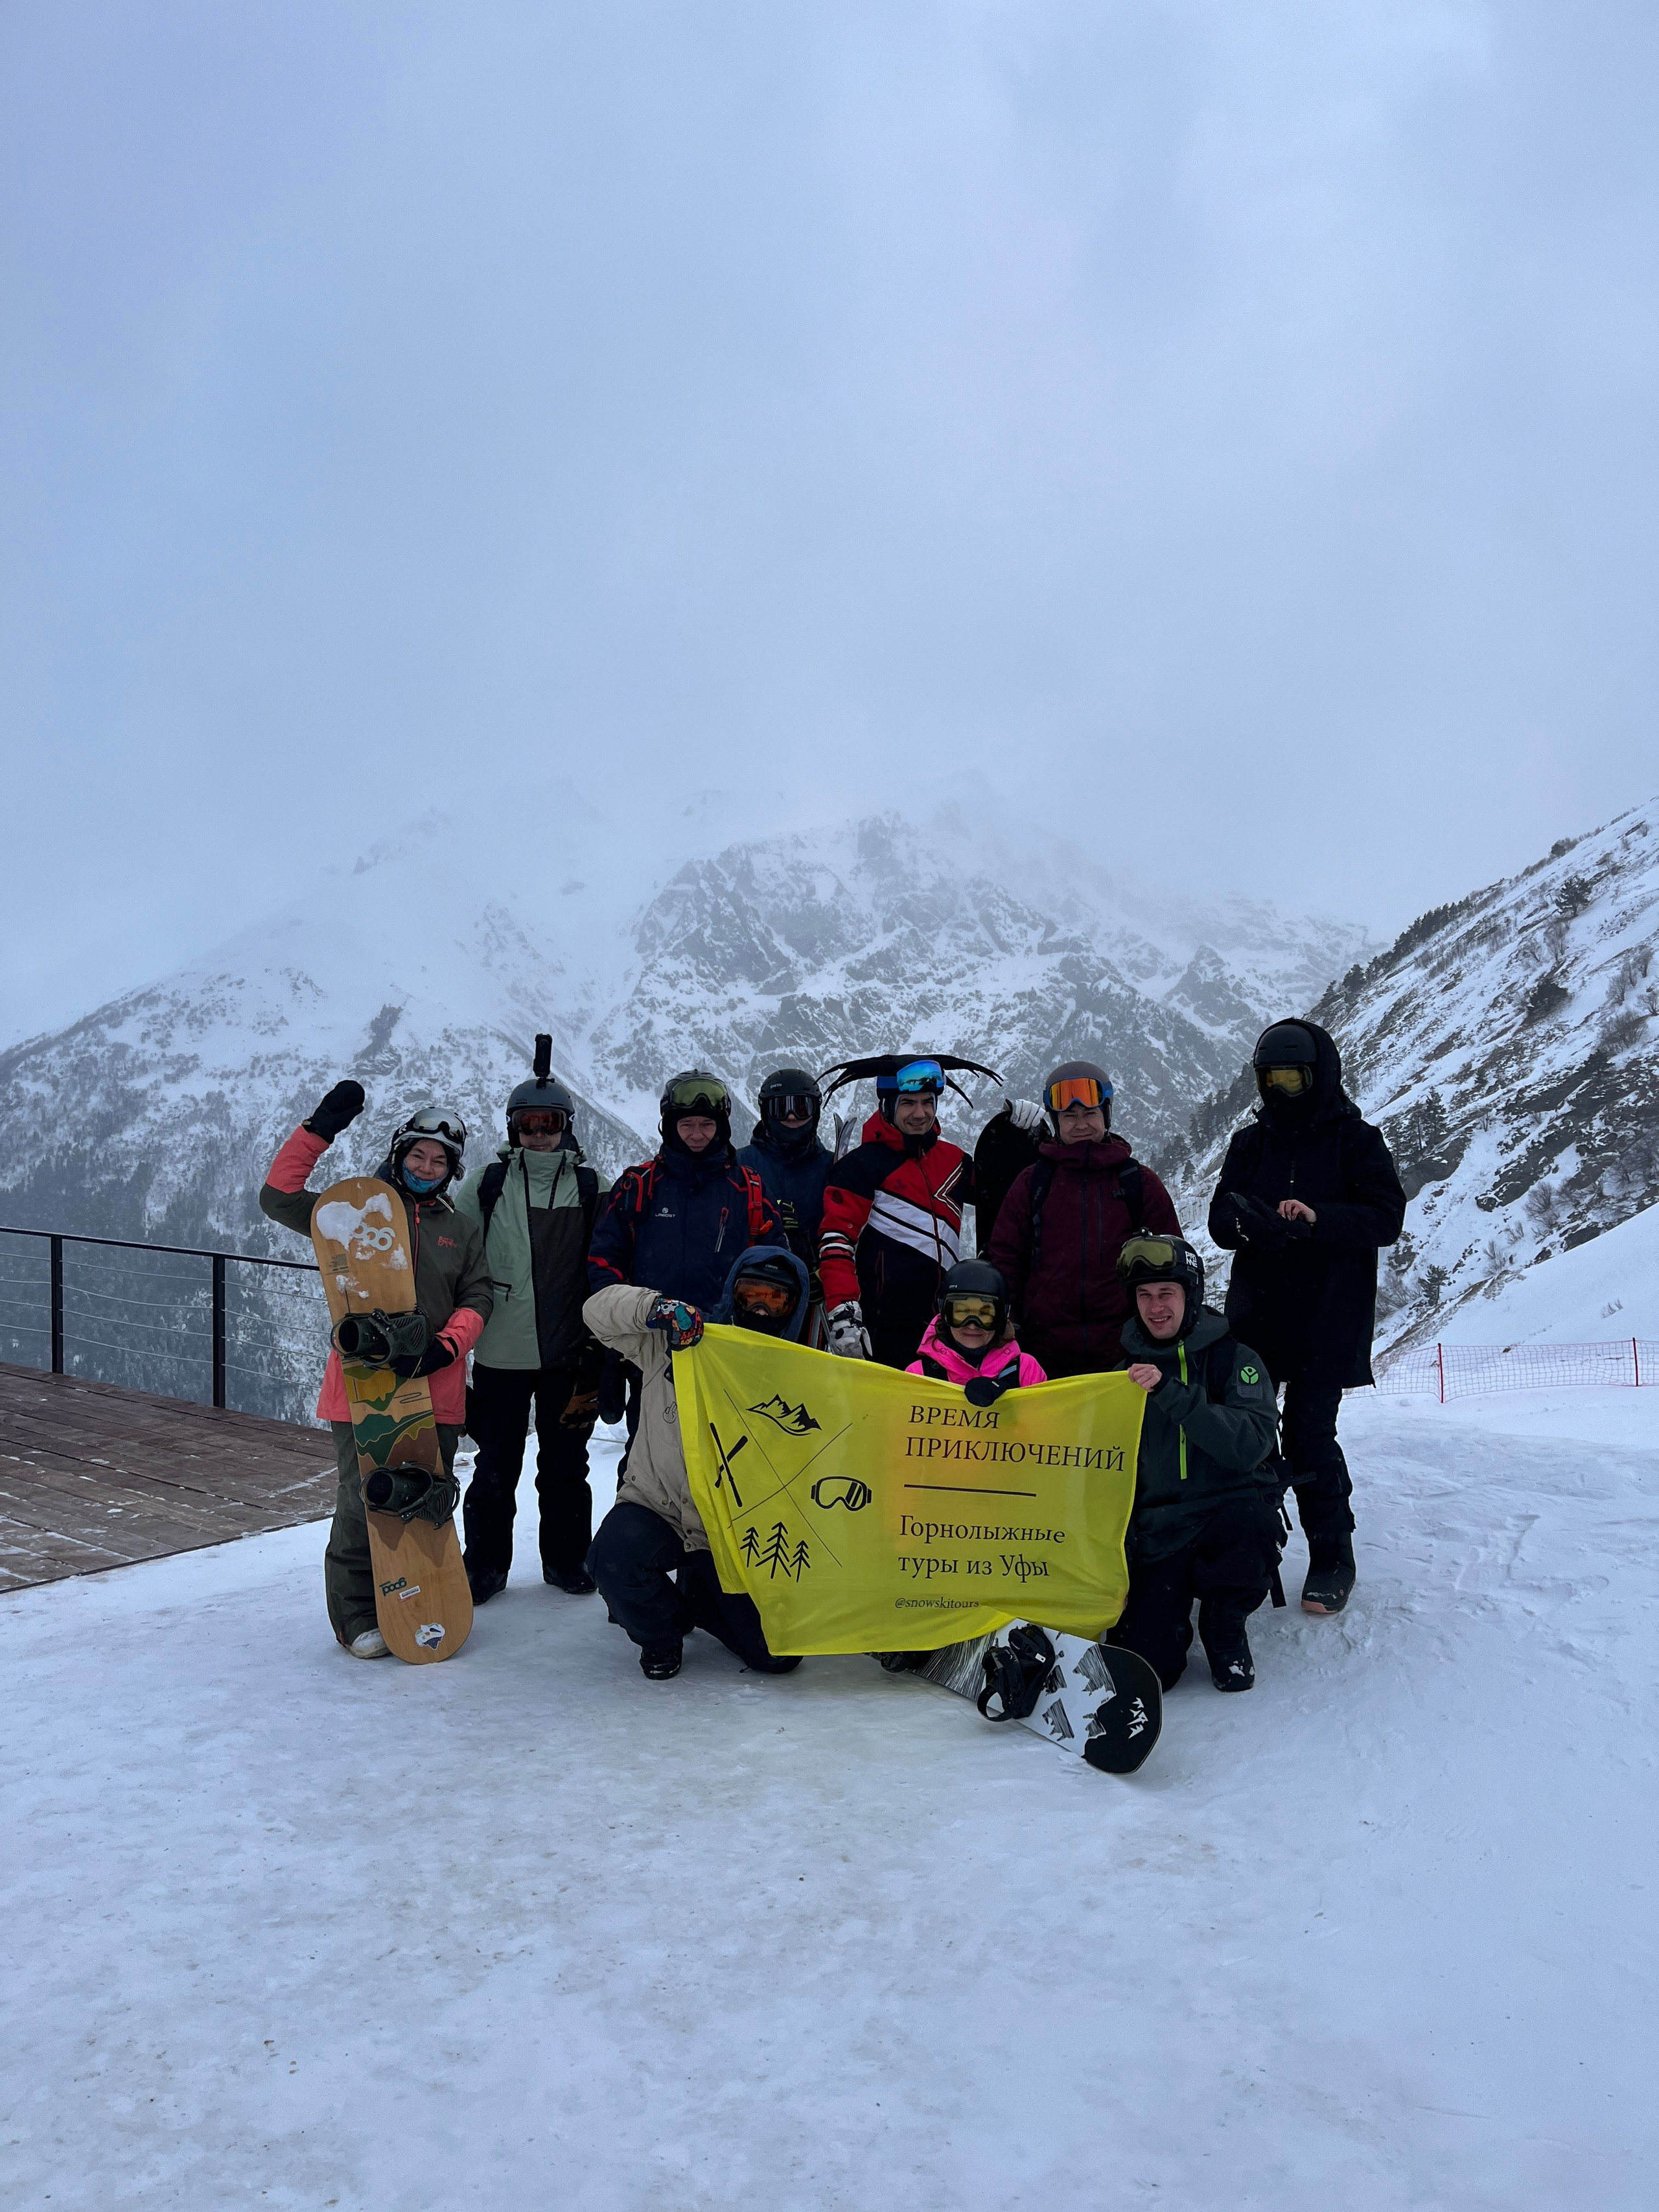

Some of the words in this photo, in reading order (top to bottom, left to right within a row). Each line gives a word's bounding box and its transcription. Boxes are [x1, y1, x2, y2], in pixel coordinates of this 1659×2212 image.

[908, 1405, 1001, 1429] ВРЕМЯ
[905, 1436, 1126, 1472] ПРИКЛЮЧЕНИЙ
[899, 1515, 1066, 1544] Горнолыжные
[898, 1557, 959, 1579] туры
[966, 1560, 993, 1576] из
[999, 1554, 1050, 1583] Уфы
[895, 1597, 979, 1609] @snowskitours
